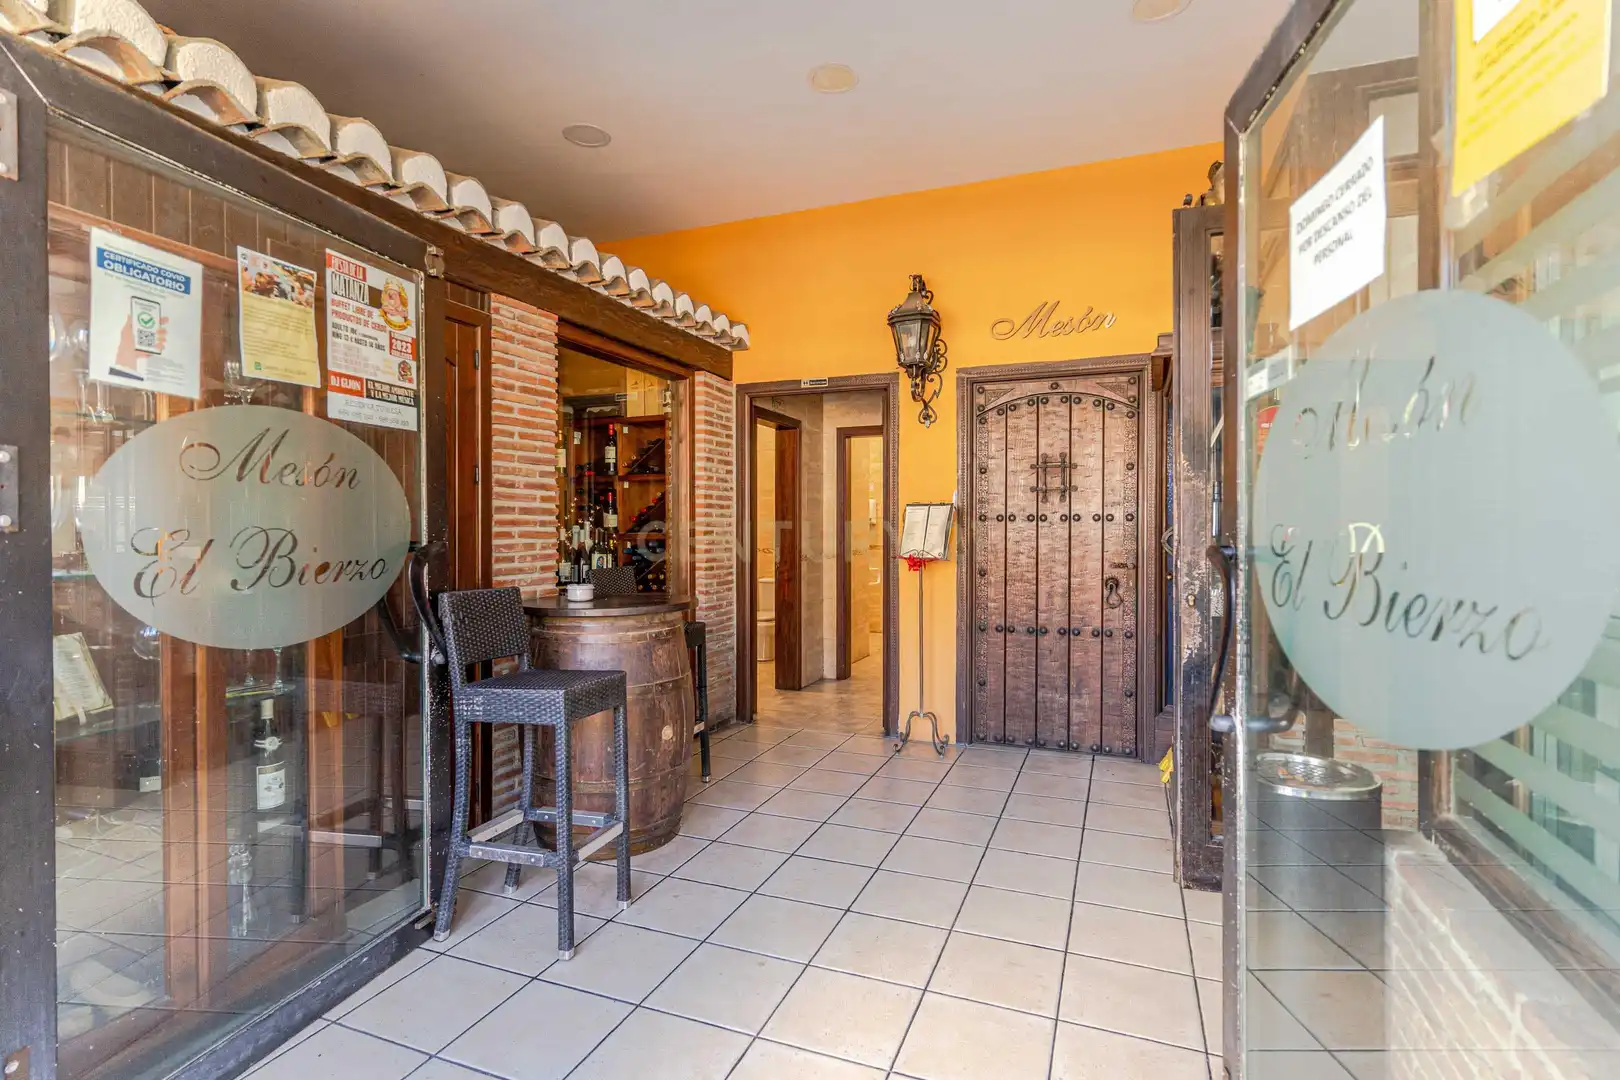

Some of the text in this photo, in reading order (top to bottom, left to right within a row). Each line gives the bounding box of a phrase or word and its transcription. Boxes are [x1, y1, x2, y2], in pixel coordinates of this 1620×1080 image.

[103, 250, 159, 274] CERTIFICADO
[160, 269, 186, 283] COVID
[103, 259, 186, 292] OBLIGATORIO
[332, 271, 369, 305] MATANZA
[990, 300, 1117, 341] Mesón
[1293, 345, 1480, 459] Món
[179, 427, 362, 489] Mesón
[130, 525, 390, 607] El Bierzo
[1271, 521, 1545, 661] El Bierzo
